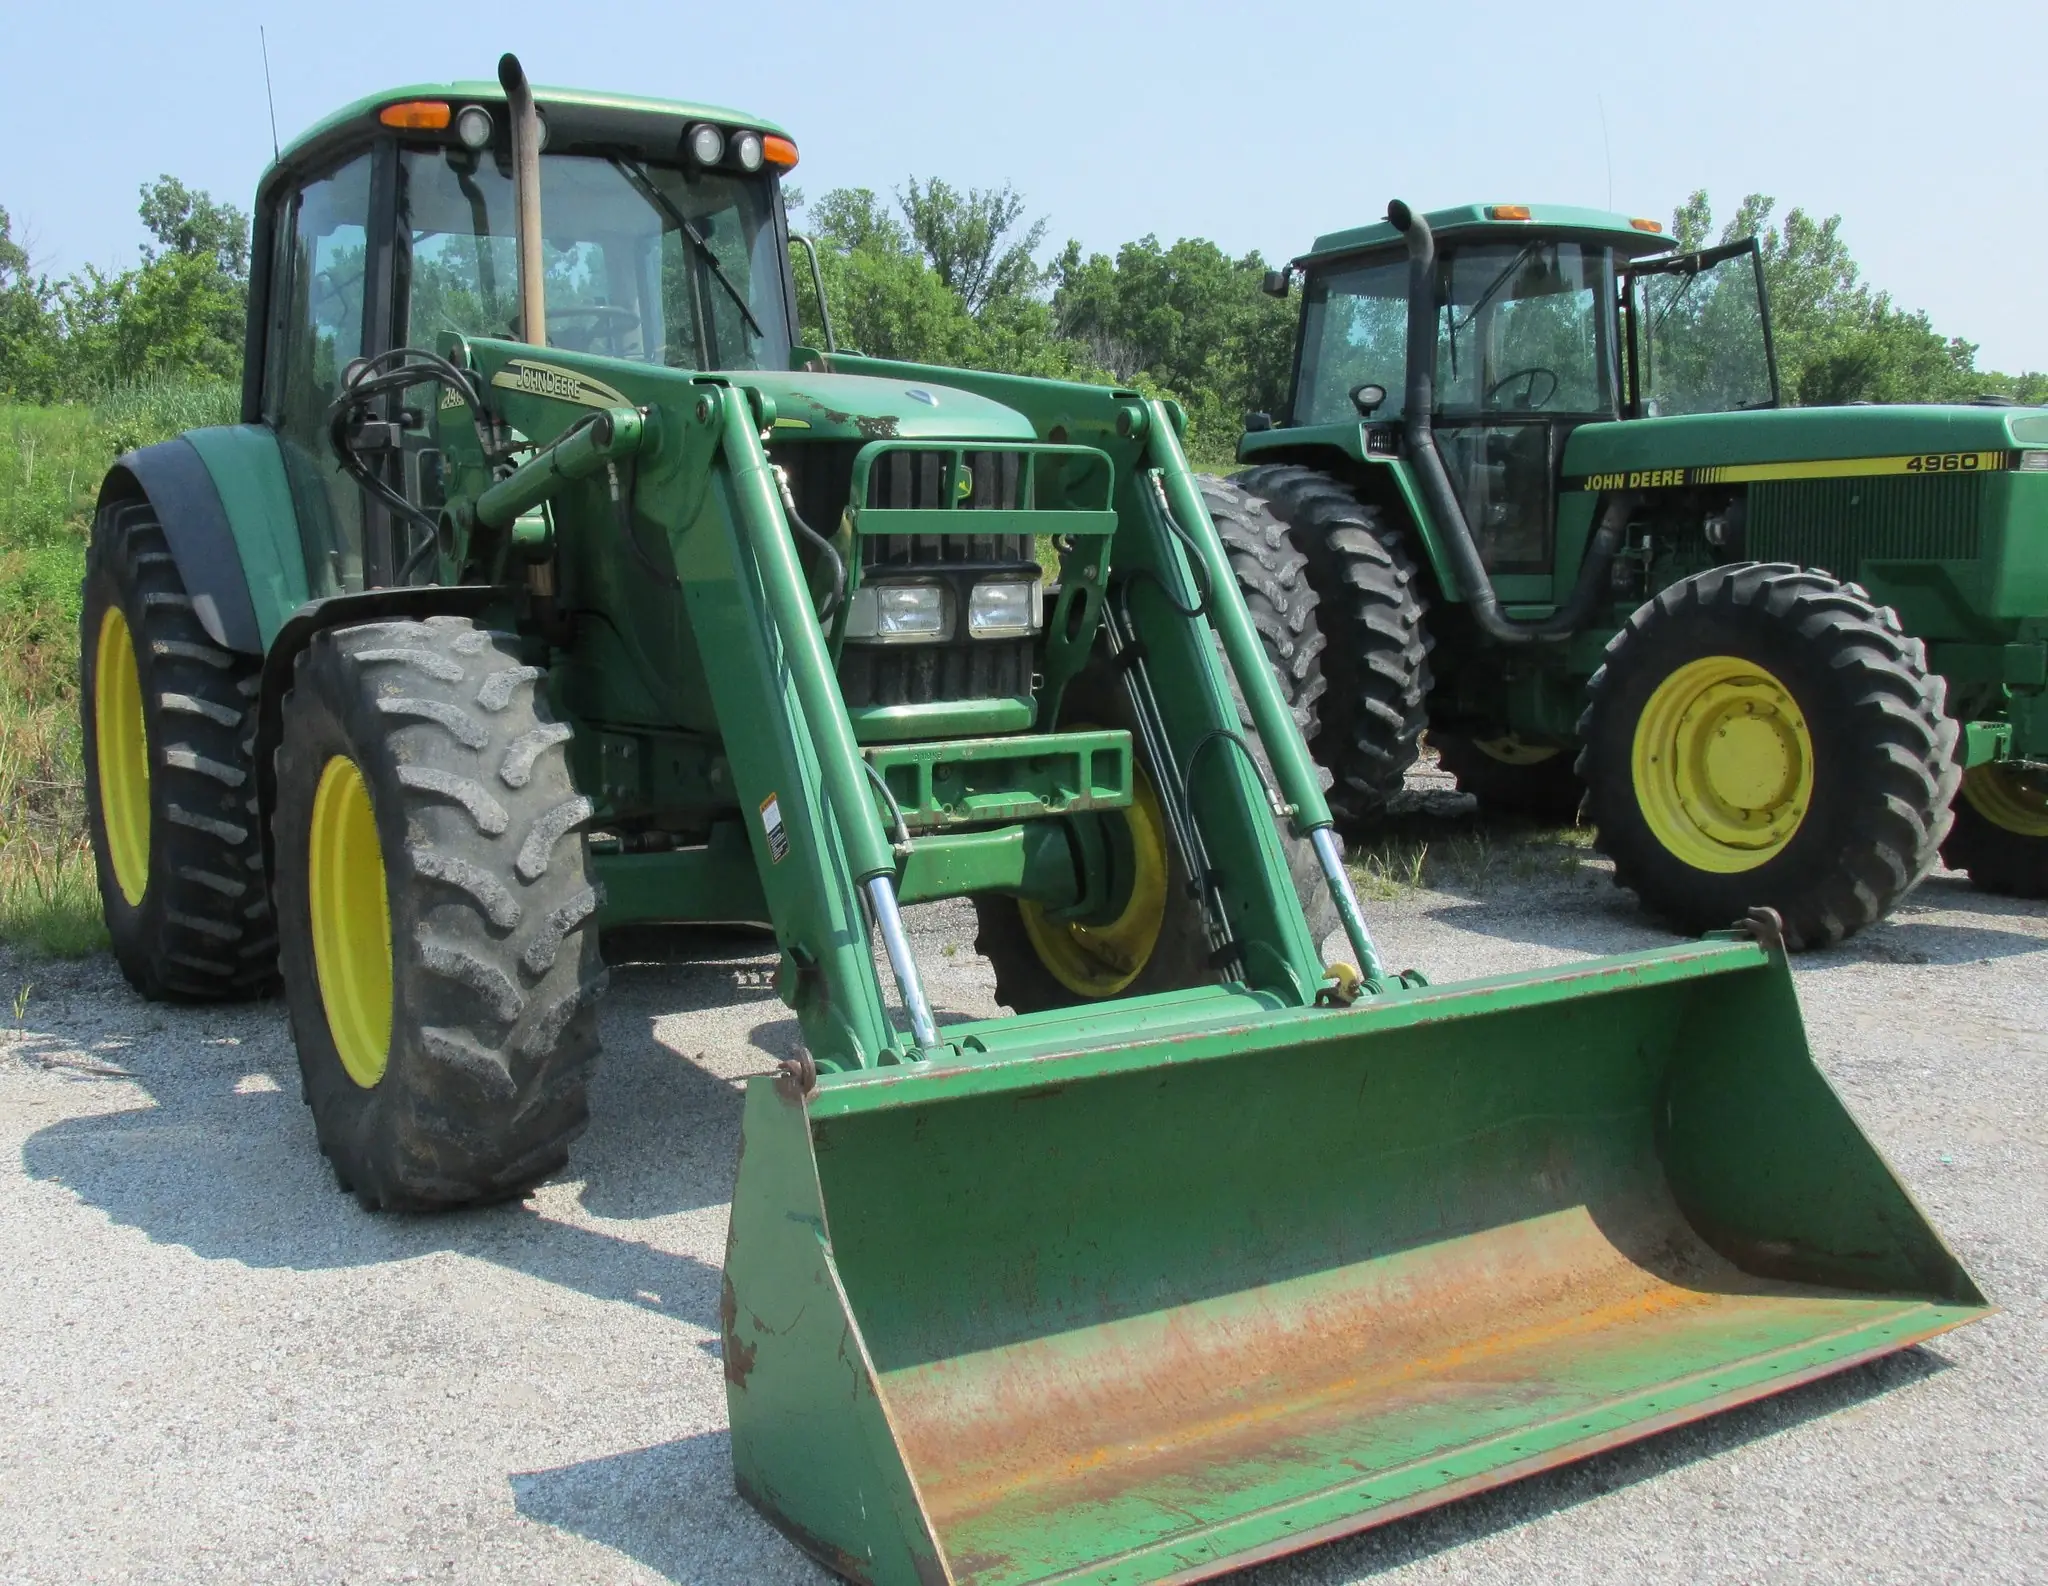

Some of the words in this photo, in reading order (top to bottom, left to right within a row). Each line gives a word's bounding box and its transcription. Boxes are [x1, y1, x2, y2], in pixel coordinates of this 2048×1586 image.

[1906, 453, 1979, 472] 4960
[1584, 473, 1625, 491] JOHN
[1629, 469, 1684, 489] DEERE
